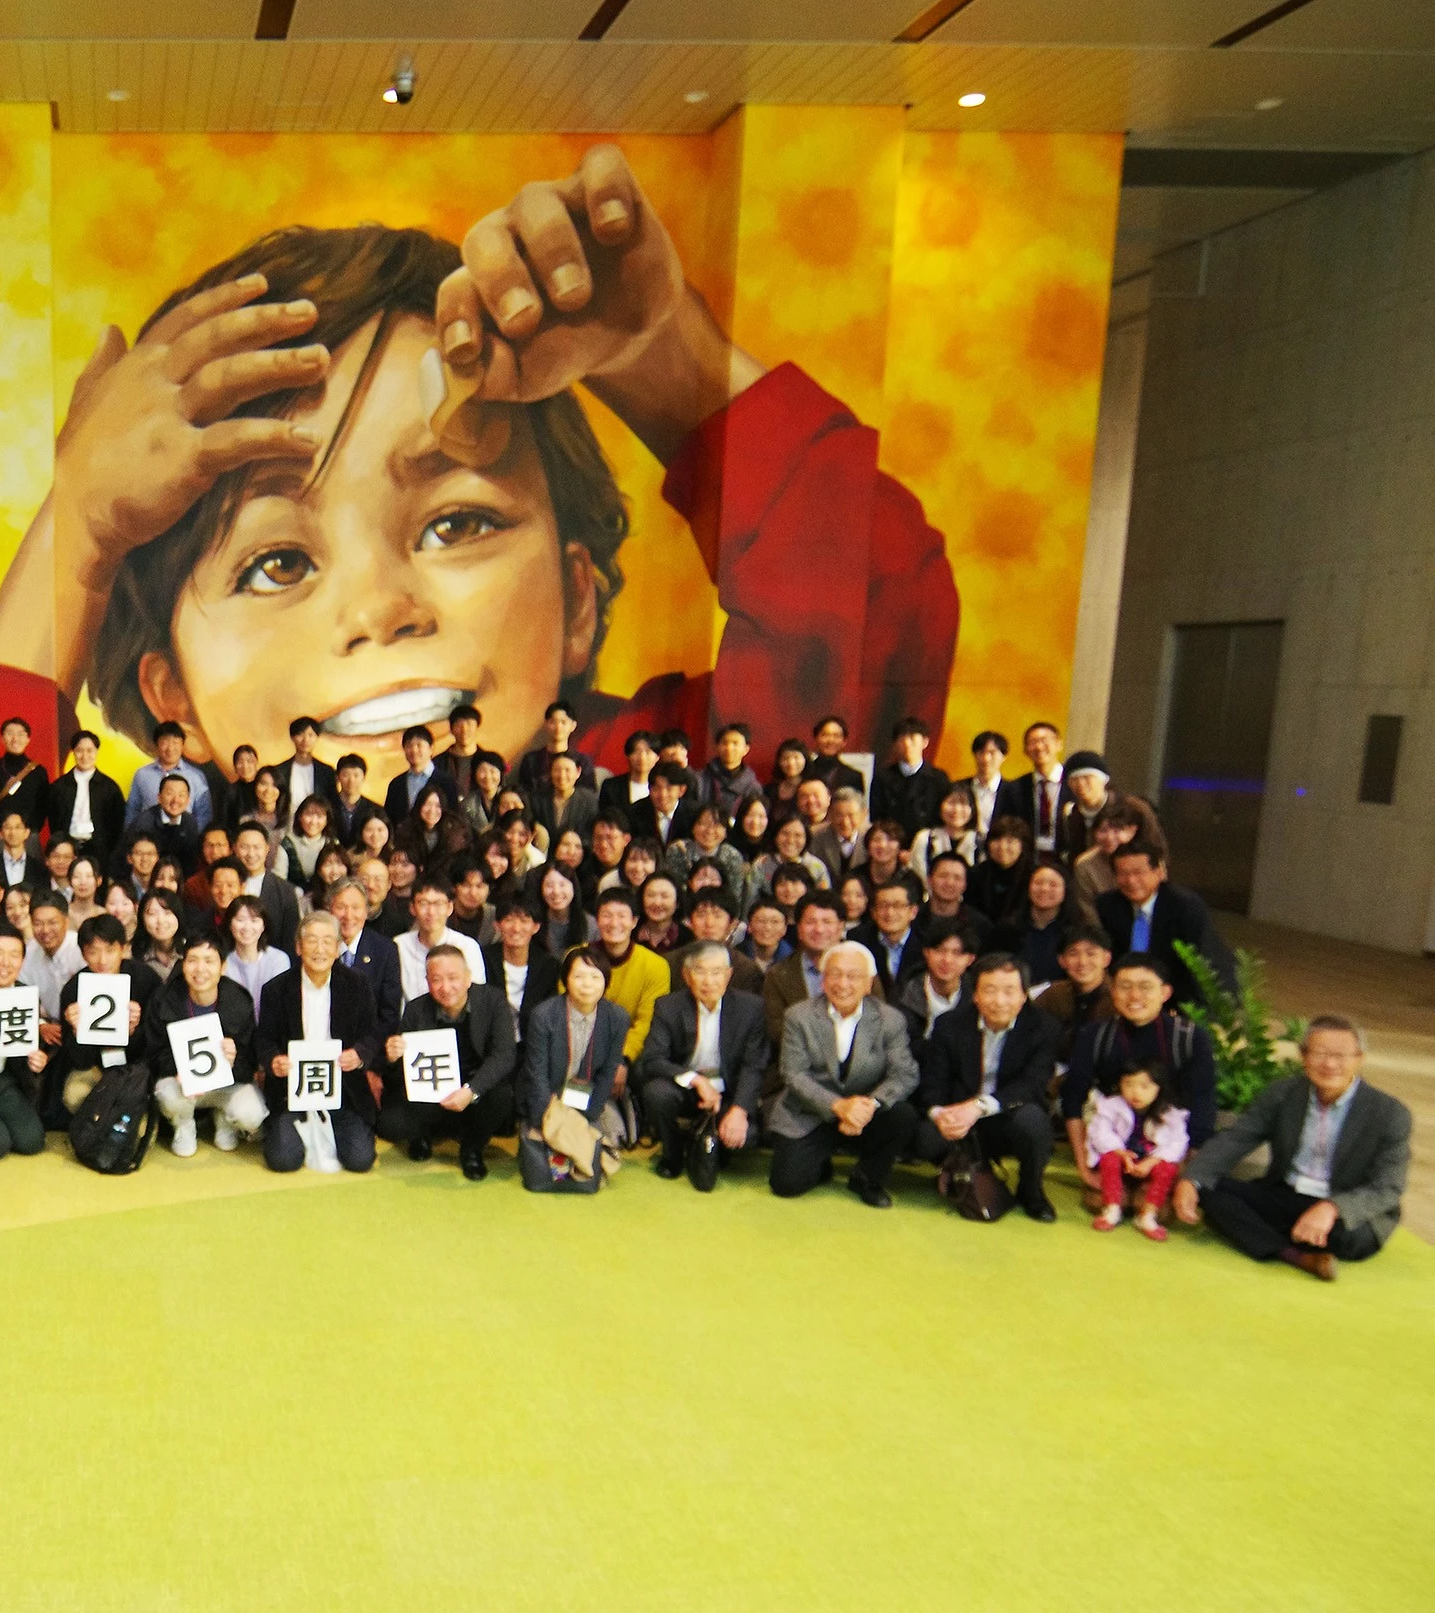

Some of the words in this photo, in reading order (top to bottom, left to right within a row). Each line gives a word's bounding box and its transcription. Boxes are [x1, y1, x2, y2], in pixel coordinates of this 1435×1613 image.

[89, 993, 116, 1032] 2
[187, 1036, 217, 1077] 5
[410, 1051, 454, 1091] 年
[294, 1059, 335, 1098] 周
